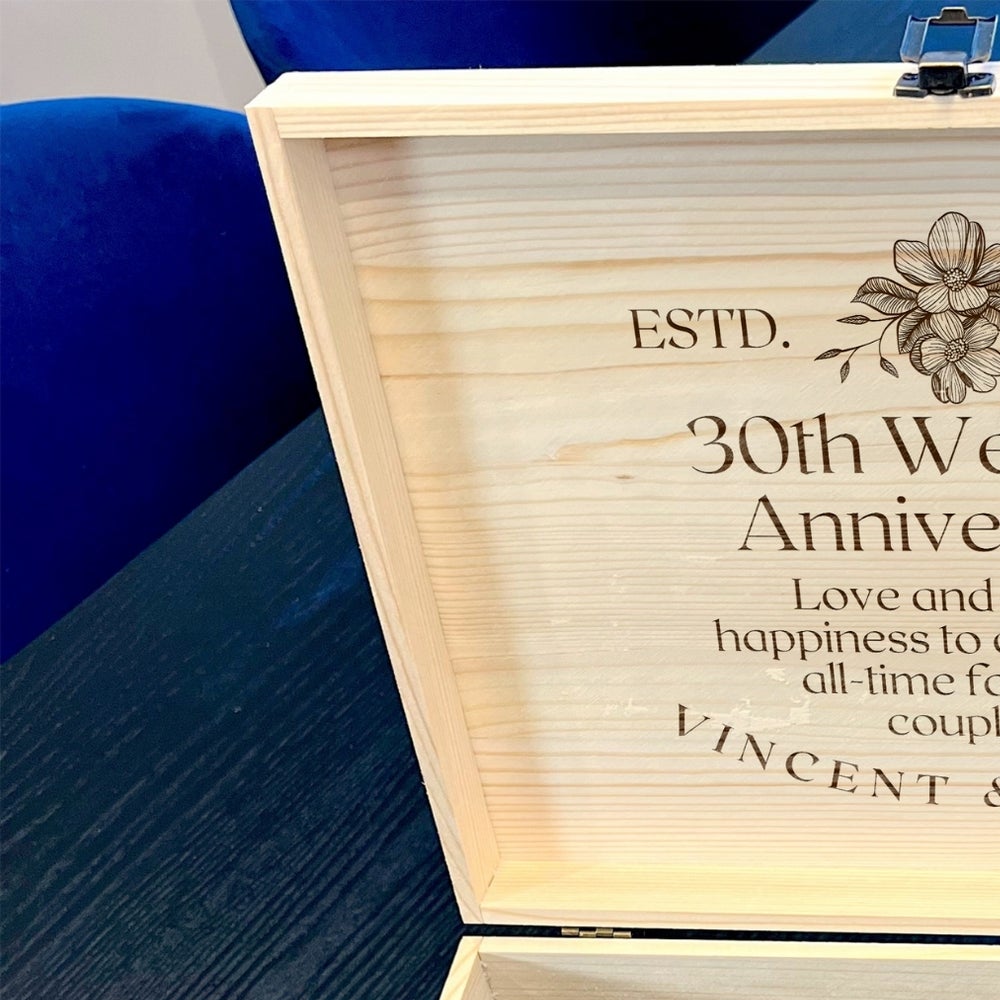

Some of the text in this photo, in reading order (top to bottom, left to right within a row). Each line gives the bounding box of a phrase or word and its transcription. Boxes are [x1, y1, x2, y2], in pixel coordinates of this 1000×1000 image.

[628, 307, 790, 350] ESTD.
[686, 412, 865, 475] 30th
[791, 577, 901, 613] Love
[912, 577, 994, 613] and
[712, 618, 930, 662] happiness
[938, 624, 982, 655] to
[801, 661, 955, 697] all-time
[676, 703, 950, 806] VINCENT
